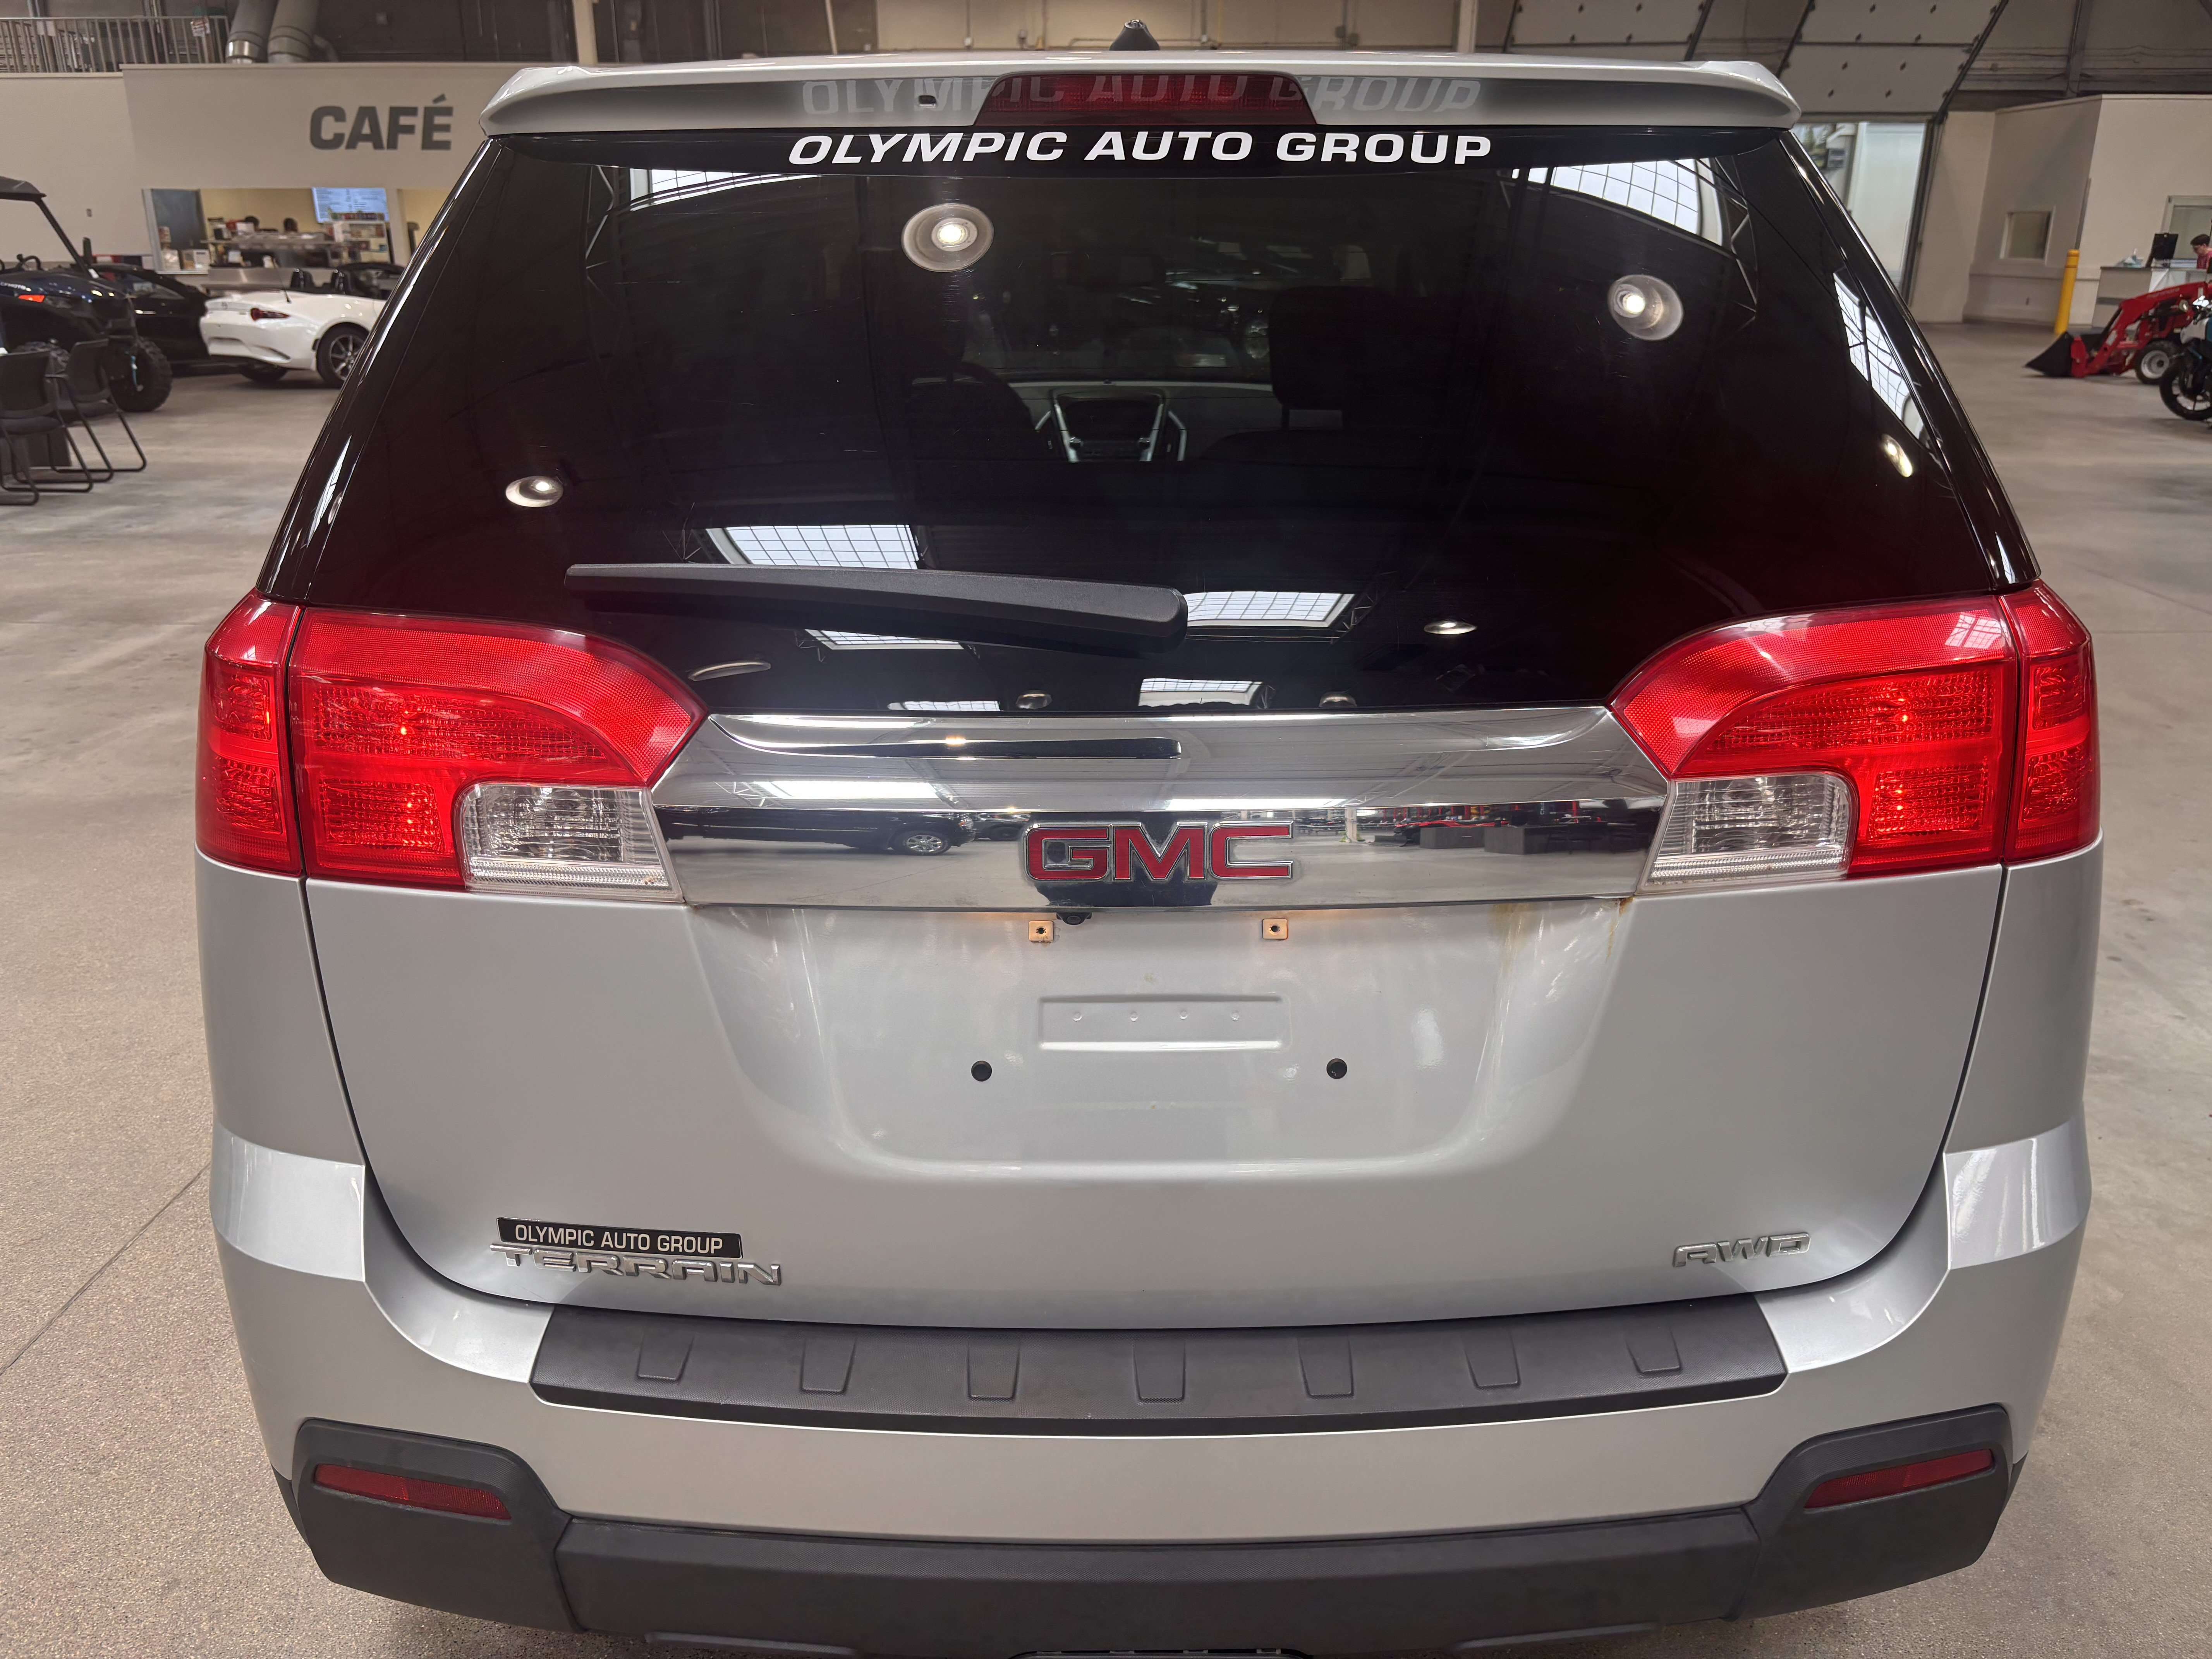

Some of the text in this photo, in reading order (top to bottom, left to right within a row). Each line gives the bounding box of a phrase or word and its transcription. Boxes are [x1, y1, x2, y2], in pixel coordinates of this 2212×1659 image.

[310, 93, 453, 150] CAFÉ
[789, 131, 1491, 165] OLYMPIC AUTO GROUP
[1024, 821, 1294, 882] GMC
[515, 1224, 723, 1254] OLYMPIC AUTO GROUP
[1672, 1232, 1811, 1267] AWD
[489, 1243, 782, 1286] TERRAIN
